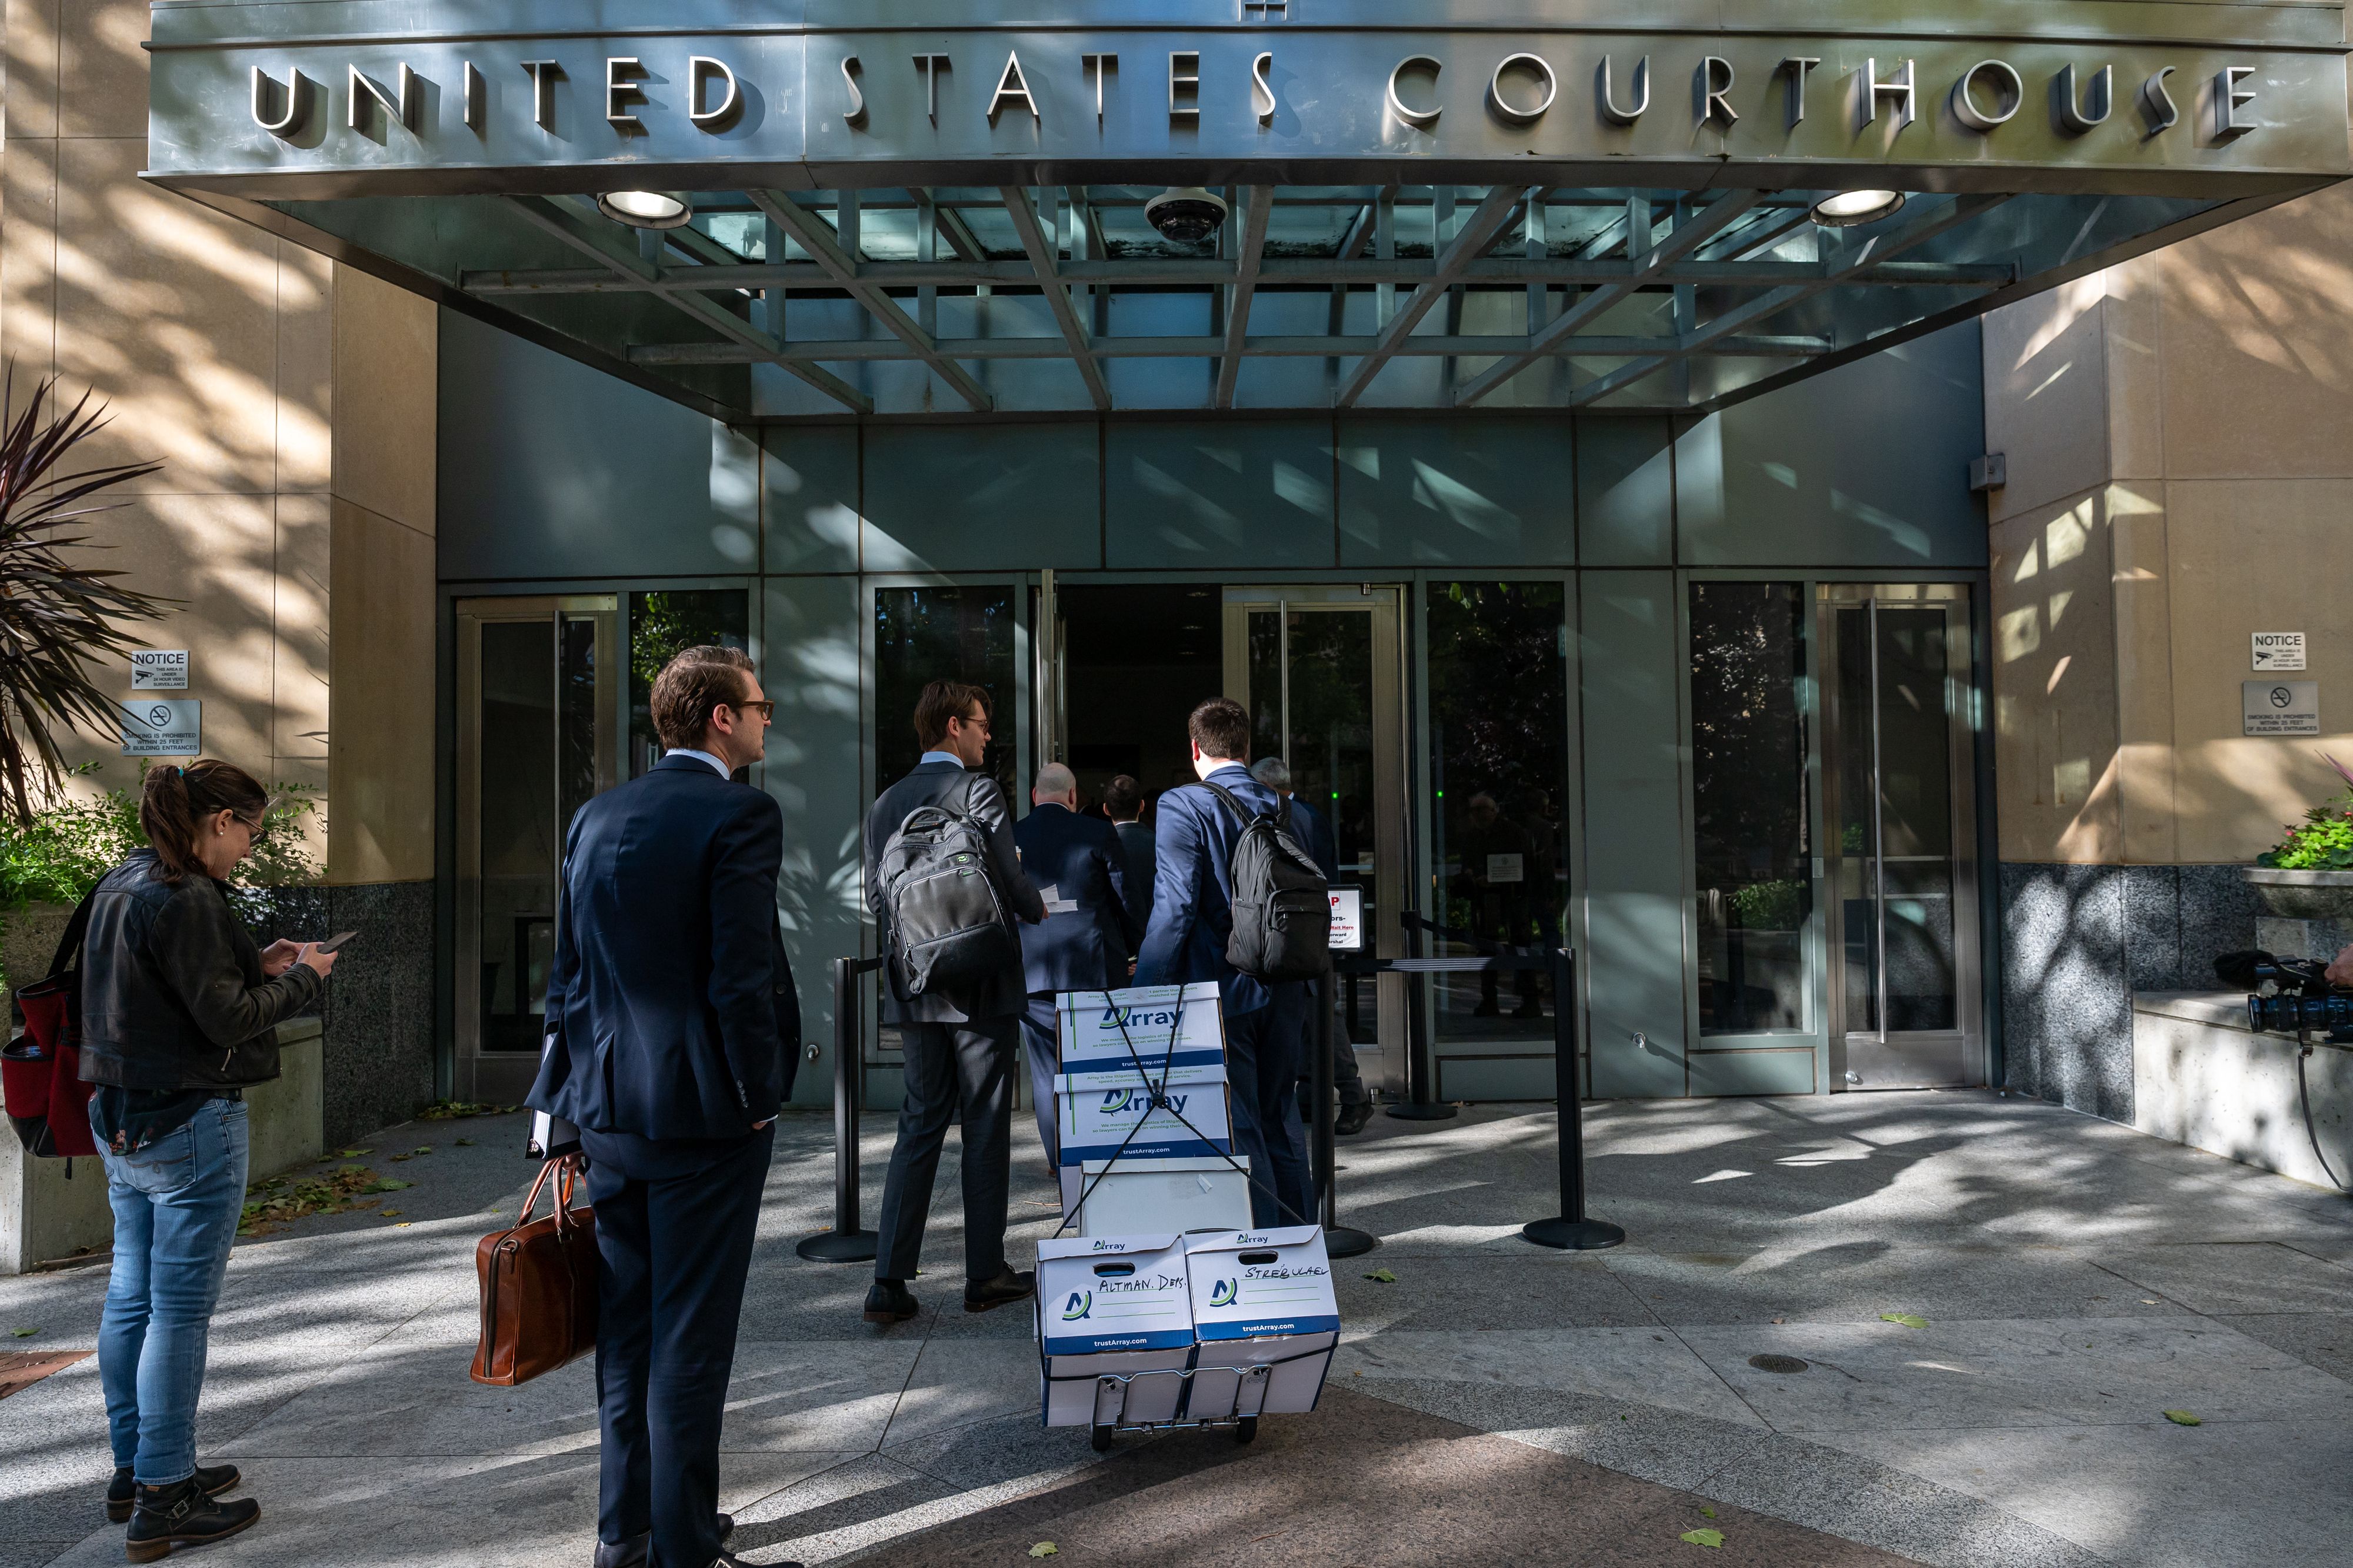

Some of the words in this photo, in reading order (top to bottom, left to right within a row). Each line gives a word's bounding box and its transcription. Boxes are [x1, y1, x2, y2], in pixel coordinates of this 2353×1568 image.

[251, 55, 739, 131] UNITED
[841, 49, 1276, 124] STATES
[1388, 52, 2258, 135] COURTHOUSE
[2255, 636, 2301, 646] NOTICE
[136, 653, 184, 664] NOTICE
[1099, 1007, 1184, 1029] Array
[1237, 1233, 1268, 1243] Array
[1092, 1240, 1125, 1250] Array
[1242, 1323, 1294, 1332] trustArray.com
[1094, 1337, 1147, 1347] trustArray.com
